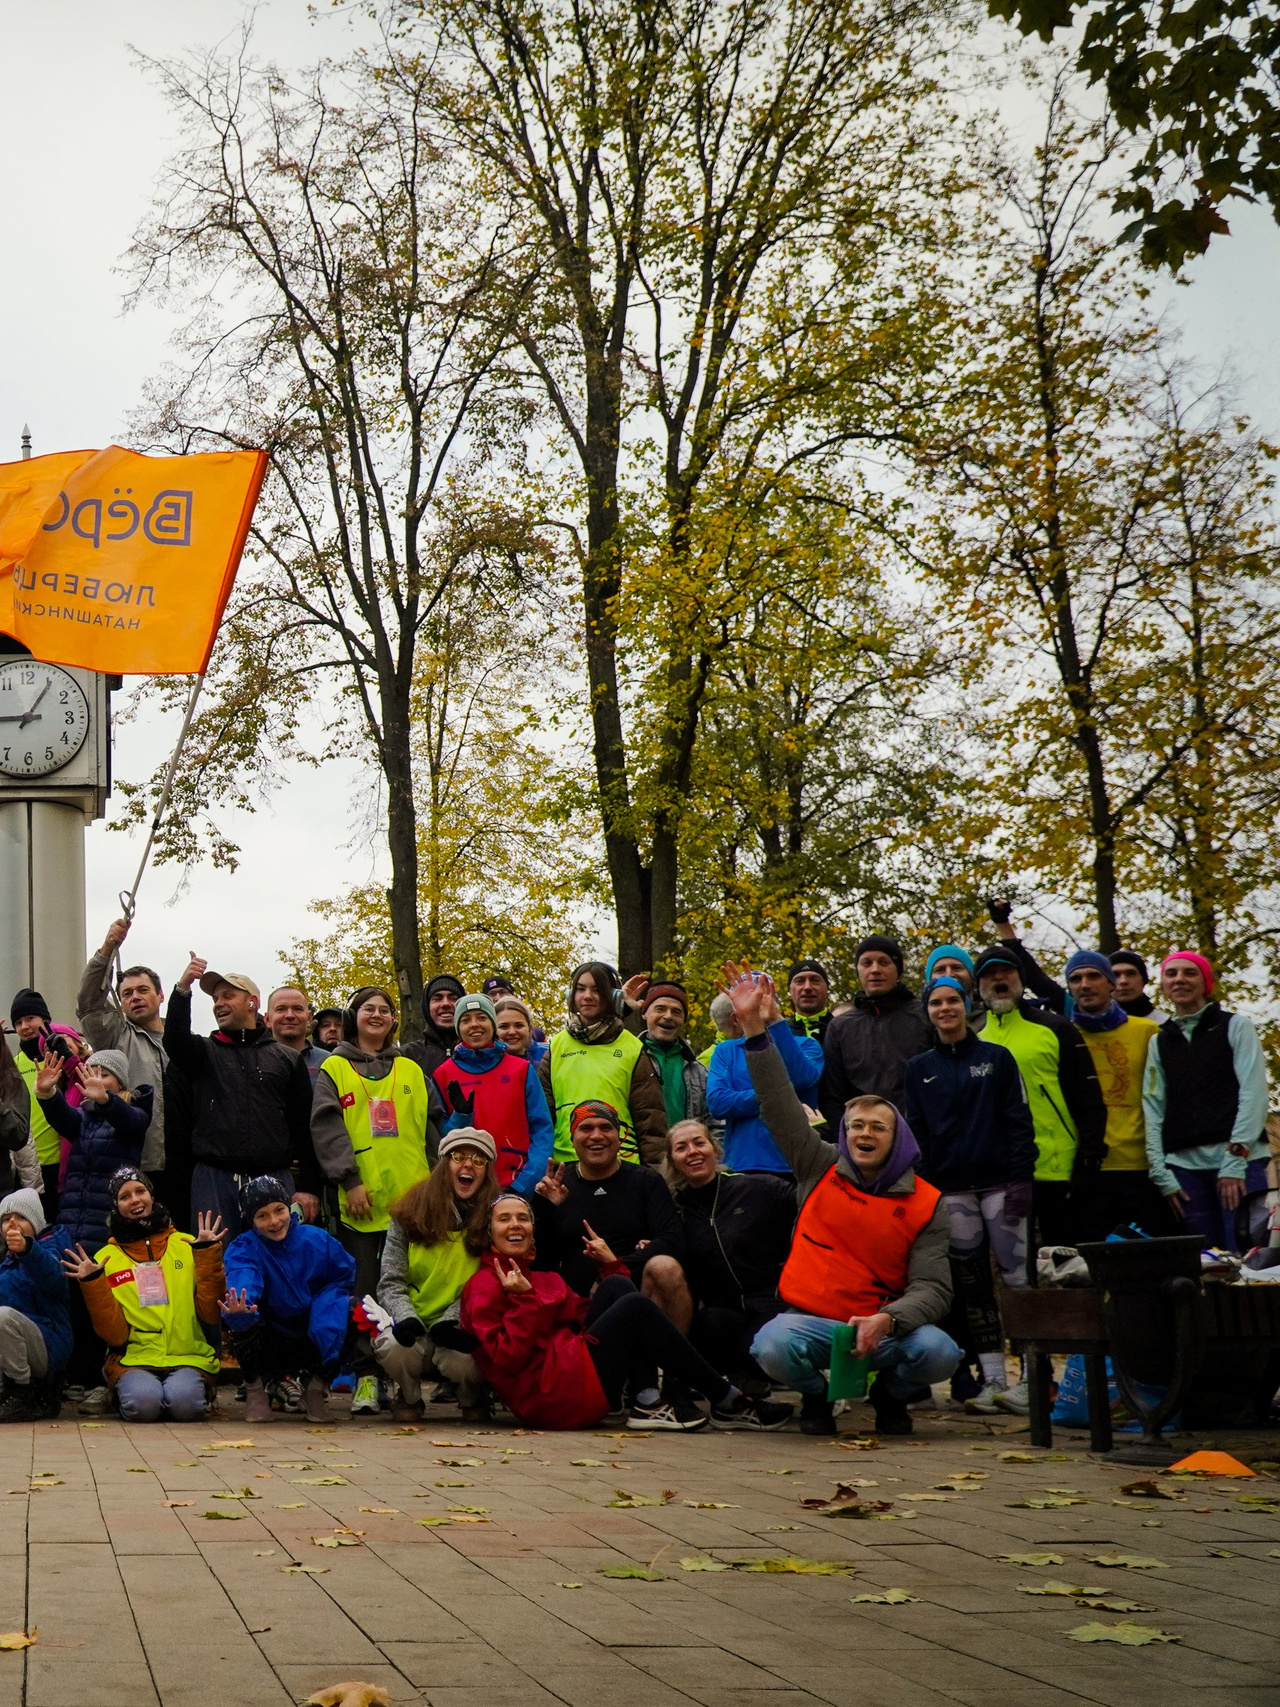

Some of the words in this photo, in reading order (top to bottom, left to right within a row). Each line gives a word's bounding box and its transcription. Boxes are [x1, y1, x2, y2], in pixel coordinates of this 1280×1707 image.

[2, 677, 12, 691] 11
[20, 671, 35, 685] 12
[59, 690, 69, 705] 2
[65, 710, 75, 725] 3
[60, 731, 69, 745] 4
[3, 747, 12, 761] 7
[23, 751, 33, 766] 6
[45, 746, 54, 760] 5
